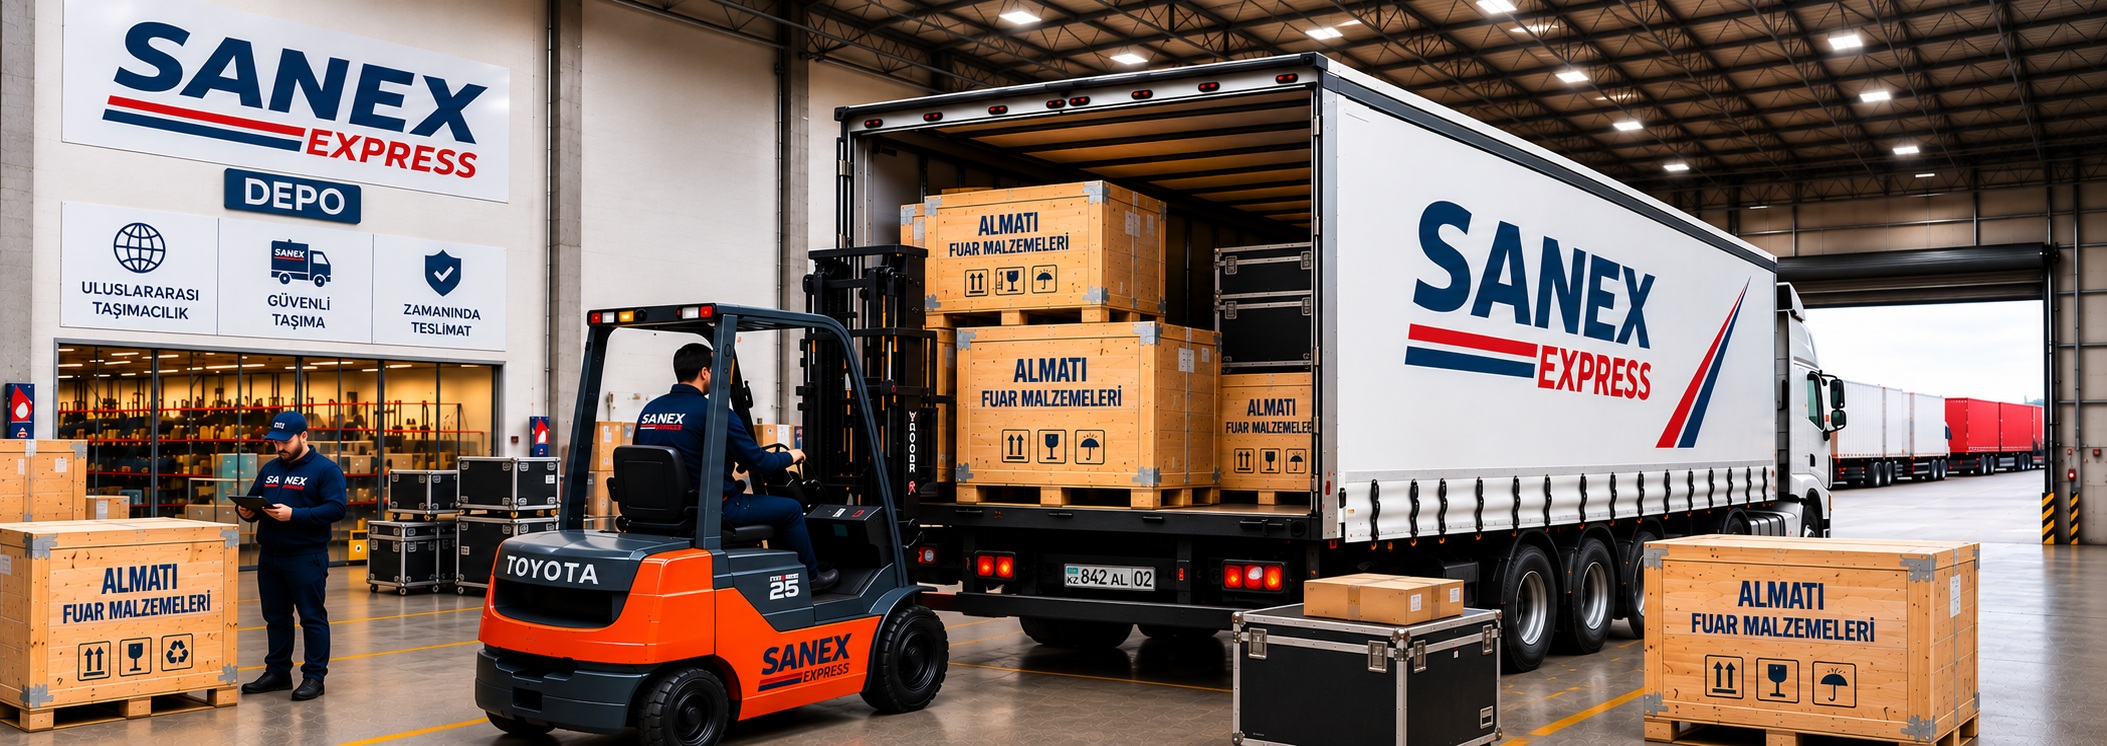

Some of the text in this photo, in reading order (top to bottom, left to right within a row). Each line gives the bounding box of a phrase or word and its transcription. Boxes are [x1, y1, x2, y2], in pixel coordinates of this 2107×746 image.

[113, 20, 489, 145] SANEX
[306, 128, 478, 179] EXPRESS
[244, 177, 346, 216] DEPO
[979, 211, 1038, 236] ALMATI
[274, 248, 305, 258] SANEX
[949, 231, 1070, 258] FUAR MALZEMELERİ
[1412, 200, 1657, 350] SANEX
[81, 281, 200, 301] ULUSLARARASI
[267, 292, 331, 311] GÜVENLİ
[92, 301, 189, 321] TAŞIMACILIK
[271, 312, 326, 331] TAŞIMA
[403, 303, 482, 321] ZAMANINDA
[411, 320, 472, 337] TESLİMAT
[1013, 356, 1087, 383] ALMATI
[1537, 345, 1652, 401] EXPRESS
[981, 384, 1122, 408] FUAR MALZEMELERİ
[1246, 398, 1296, 417] ALMATI
[641, 413, 686, 424] SANEX
[1226, 421, 1249, 434] FUAR
[101, 563, 178, 596] ALMATI
[506, 556, 599, 586] TOYOTA
[1067, 568, 1153, 588] KZ 842 AL 02
[769, 579, 800, 600] 25
[1737, 580, 1825, 611] ALMATI
[62, 590, 211, 625] FUAR MALZEMELERİ
[1691, 612, 1875, 643] FUAR MALZEMELERİ
[761, 632, 852, 676] SANEX
[803, 662, 850, 683] EXPRESS
